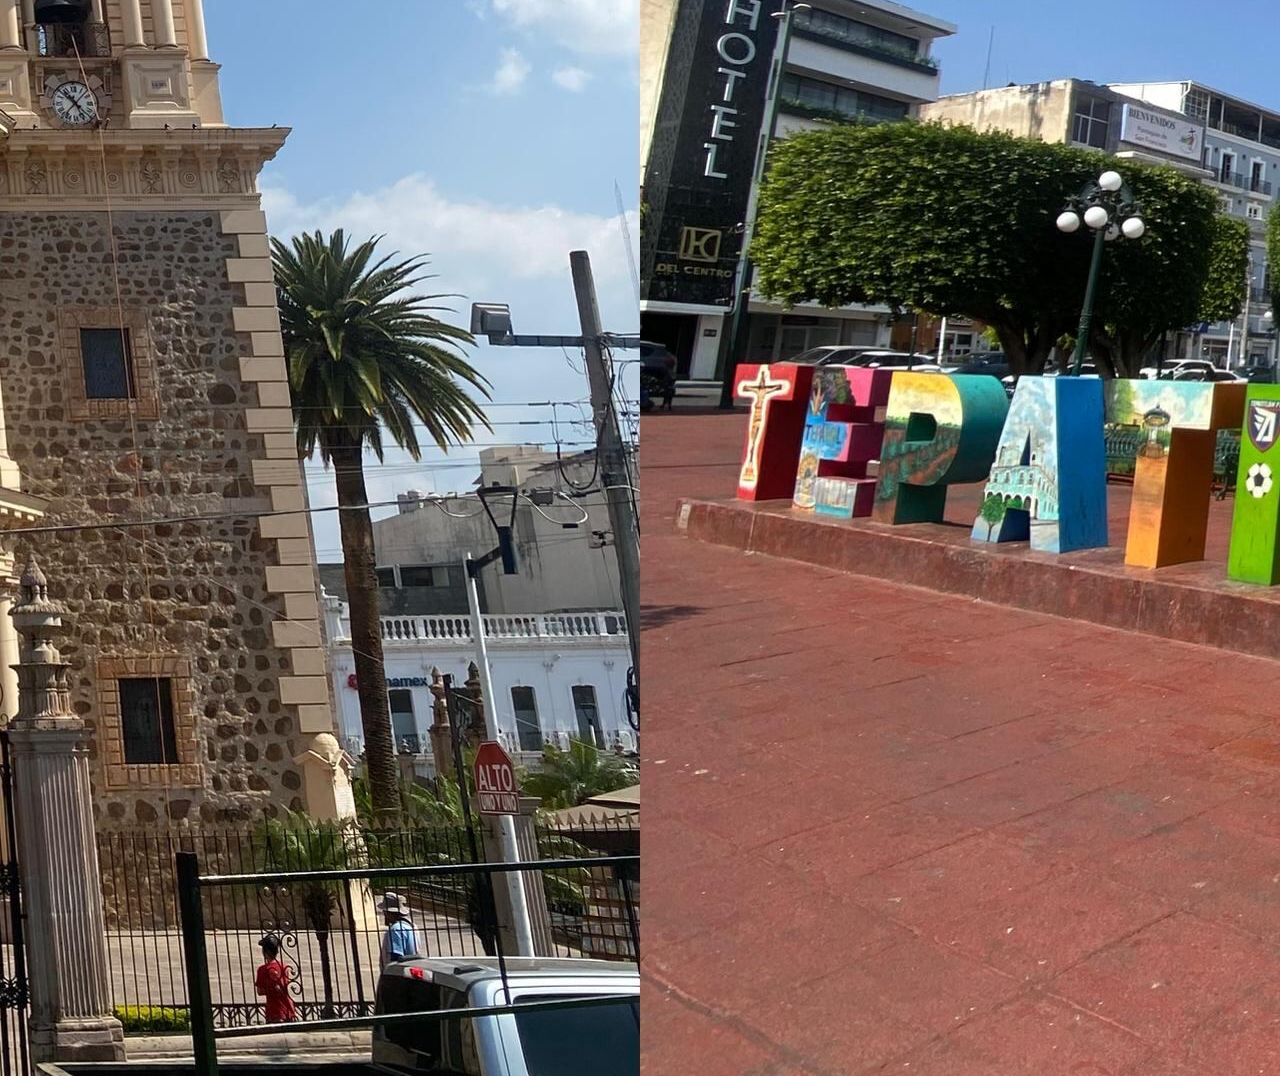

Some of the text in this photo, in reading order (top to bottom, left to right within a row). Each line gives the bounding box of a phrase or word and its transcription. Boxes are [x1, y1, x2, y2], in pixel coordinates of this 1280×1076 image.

[1129, 108, 1176, 130] BIENVENIDOS
[656, 263, 733, 278] DEL CENTRO
[385, 676, 428, 687] namex
[479, 764, 513, 792] ALTO
[480, 794, 496, 811] UNO
[501, 794, 517, 812] UNO
